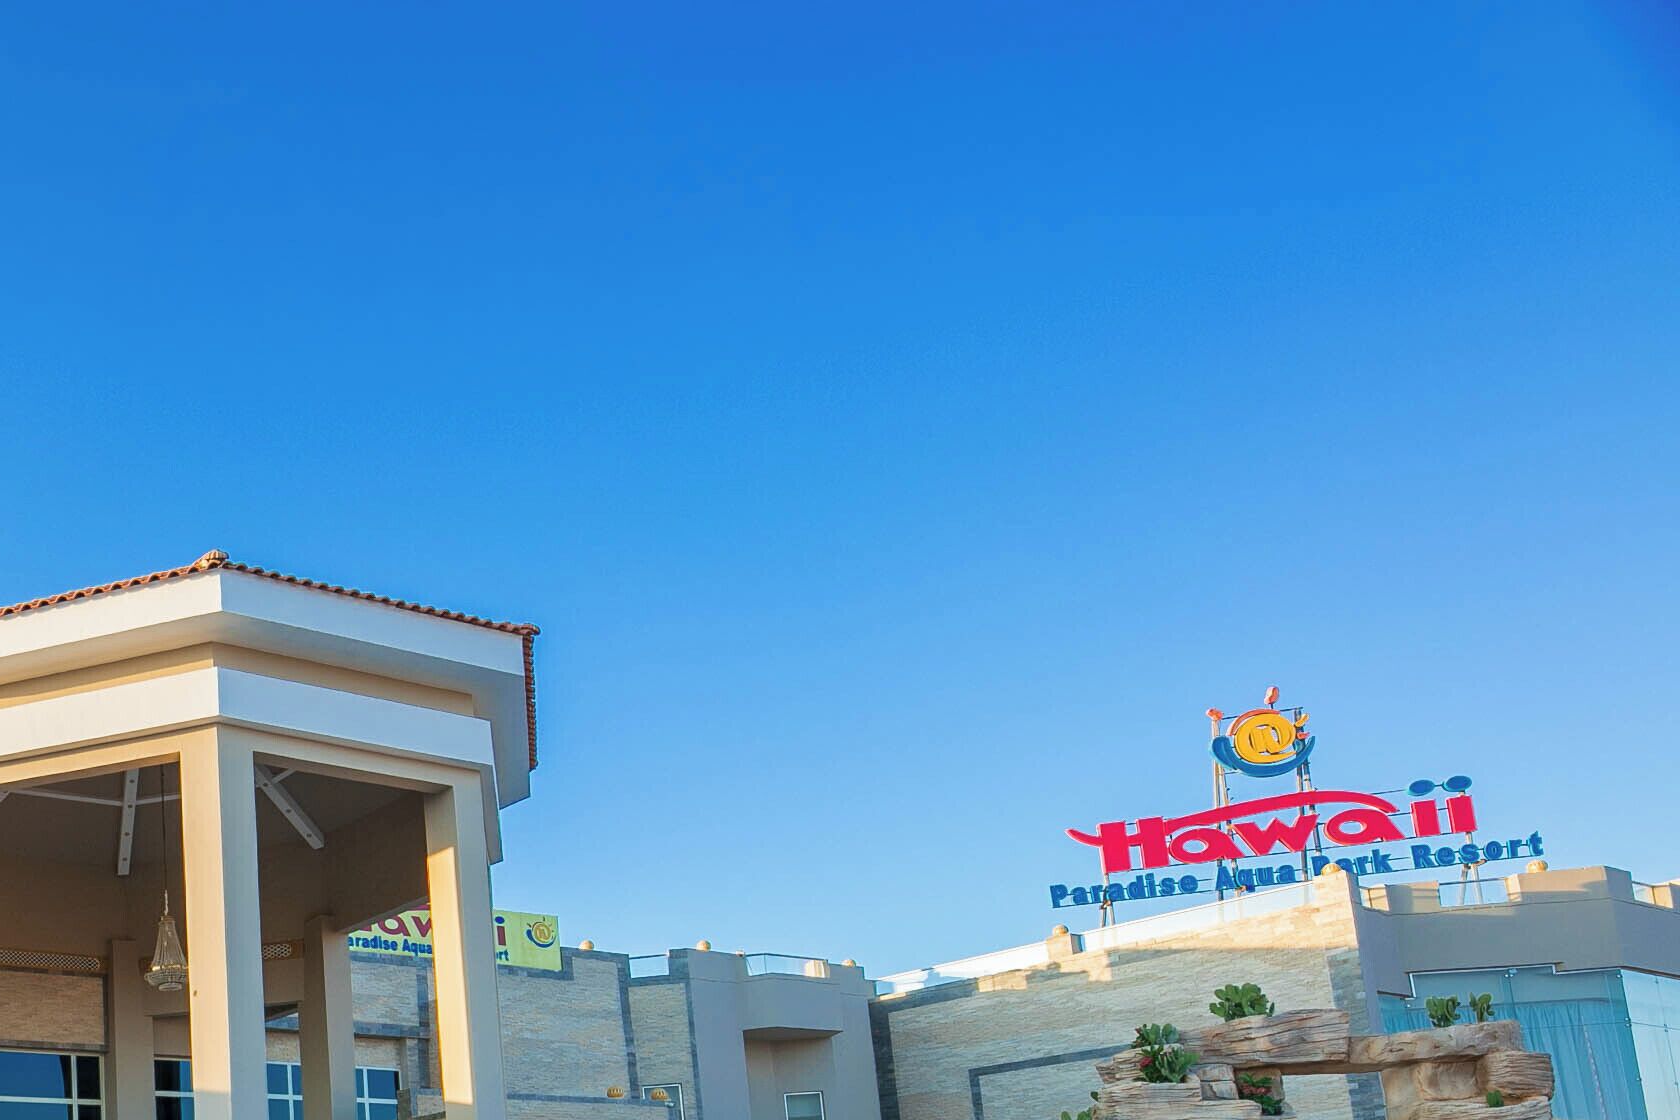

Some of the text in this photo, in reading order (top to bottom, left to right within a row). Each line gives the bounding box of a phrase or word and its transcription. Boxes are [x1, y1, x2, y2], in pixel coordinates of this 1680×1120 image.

[1065, 775, 1478, 873] Hawaii
[1050, 873, 1199, 908] Paradise
[1215, 861, 1296, 893] Aqua
[1410, 831, 1544, 869] Resort
